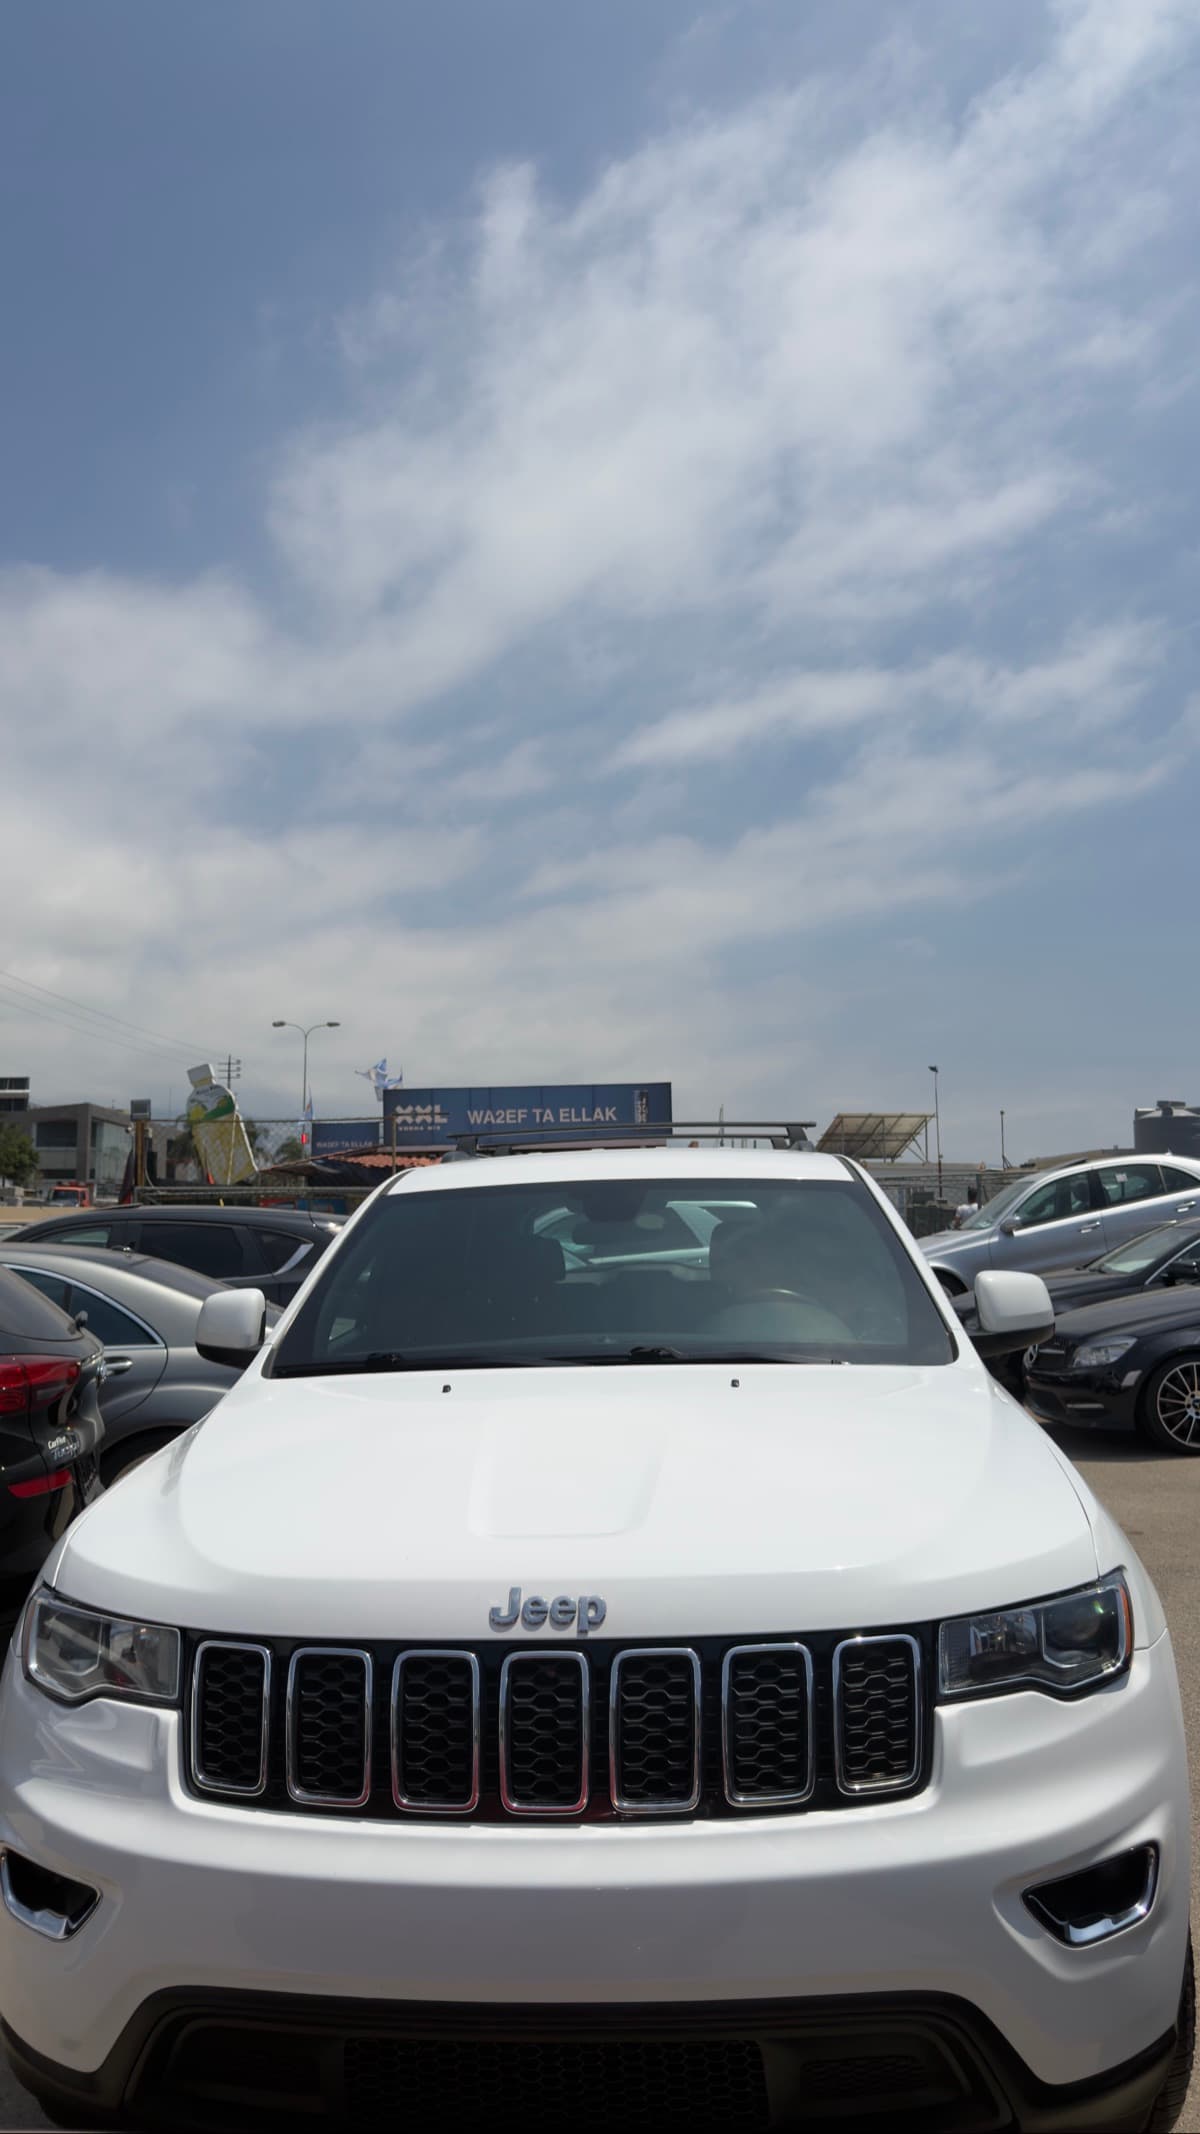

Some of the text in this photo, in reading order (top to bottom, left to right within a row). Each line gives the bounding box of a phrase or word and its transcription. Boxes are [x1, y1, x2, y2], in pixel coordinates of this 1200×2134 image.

[467, 1109, 527, 1124] WA2EF
[532, 1108, 554, 1123] TA
[559, 1106, 617, 1123] ELLAK
[489, 1587, 607, 1634] Jeep
